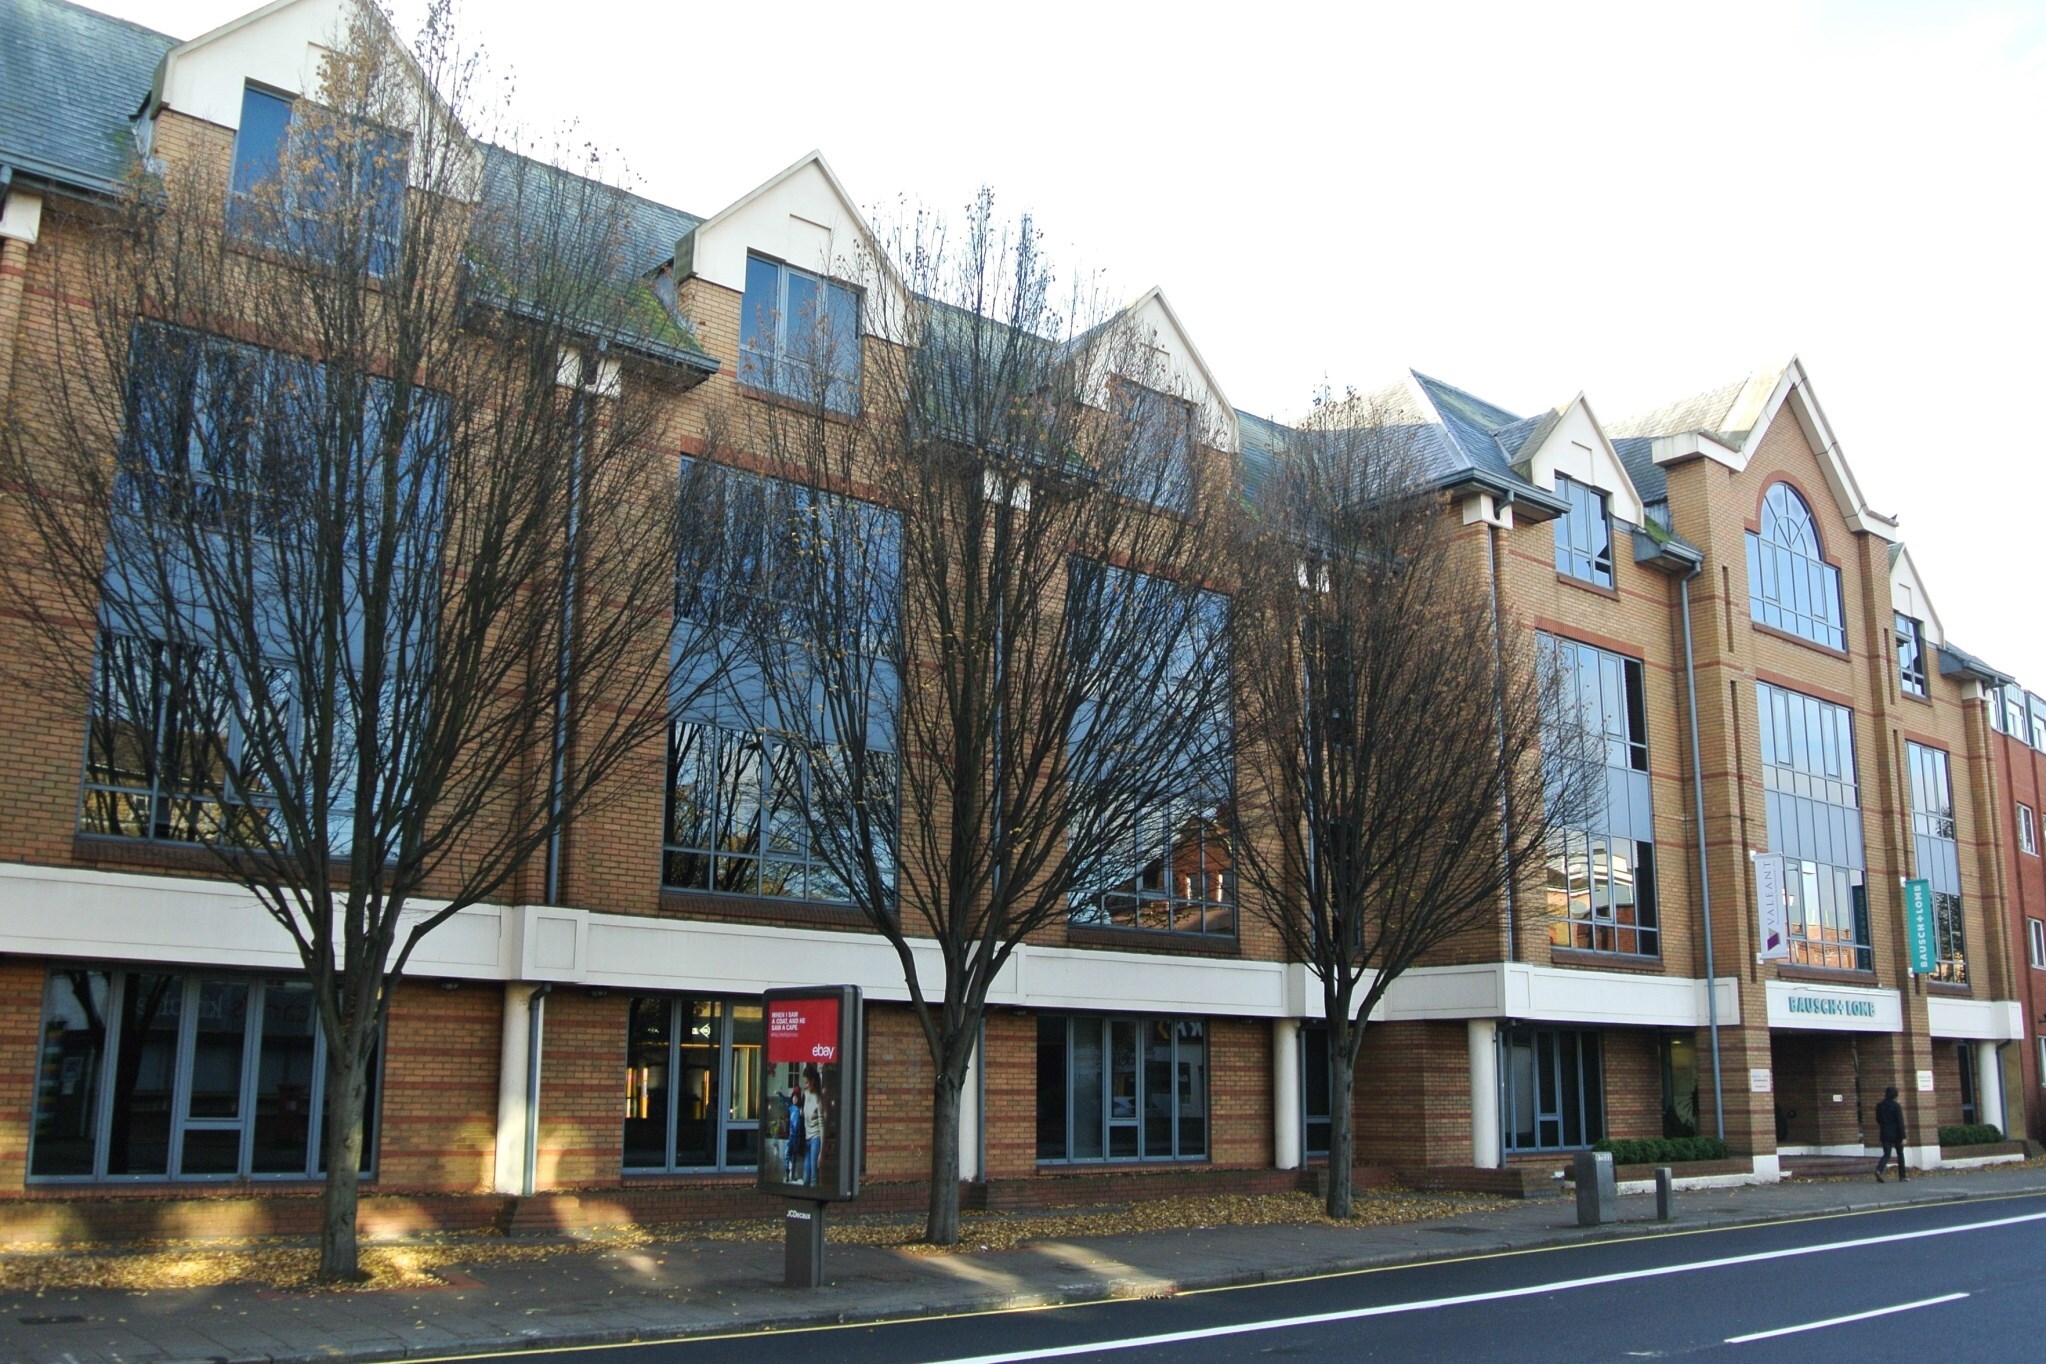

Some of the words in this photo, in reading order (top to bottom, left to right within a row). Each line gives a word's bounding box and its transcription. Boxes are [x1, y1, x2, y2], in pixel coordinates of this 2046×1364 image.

[1763, 862, 1775, 926] VALEANT
[812, 1043, 835, 1060] ebay
[786, 1209, 811, 1220] JCDecaux
